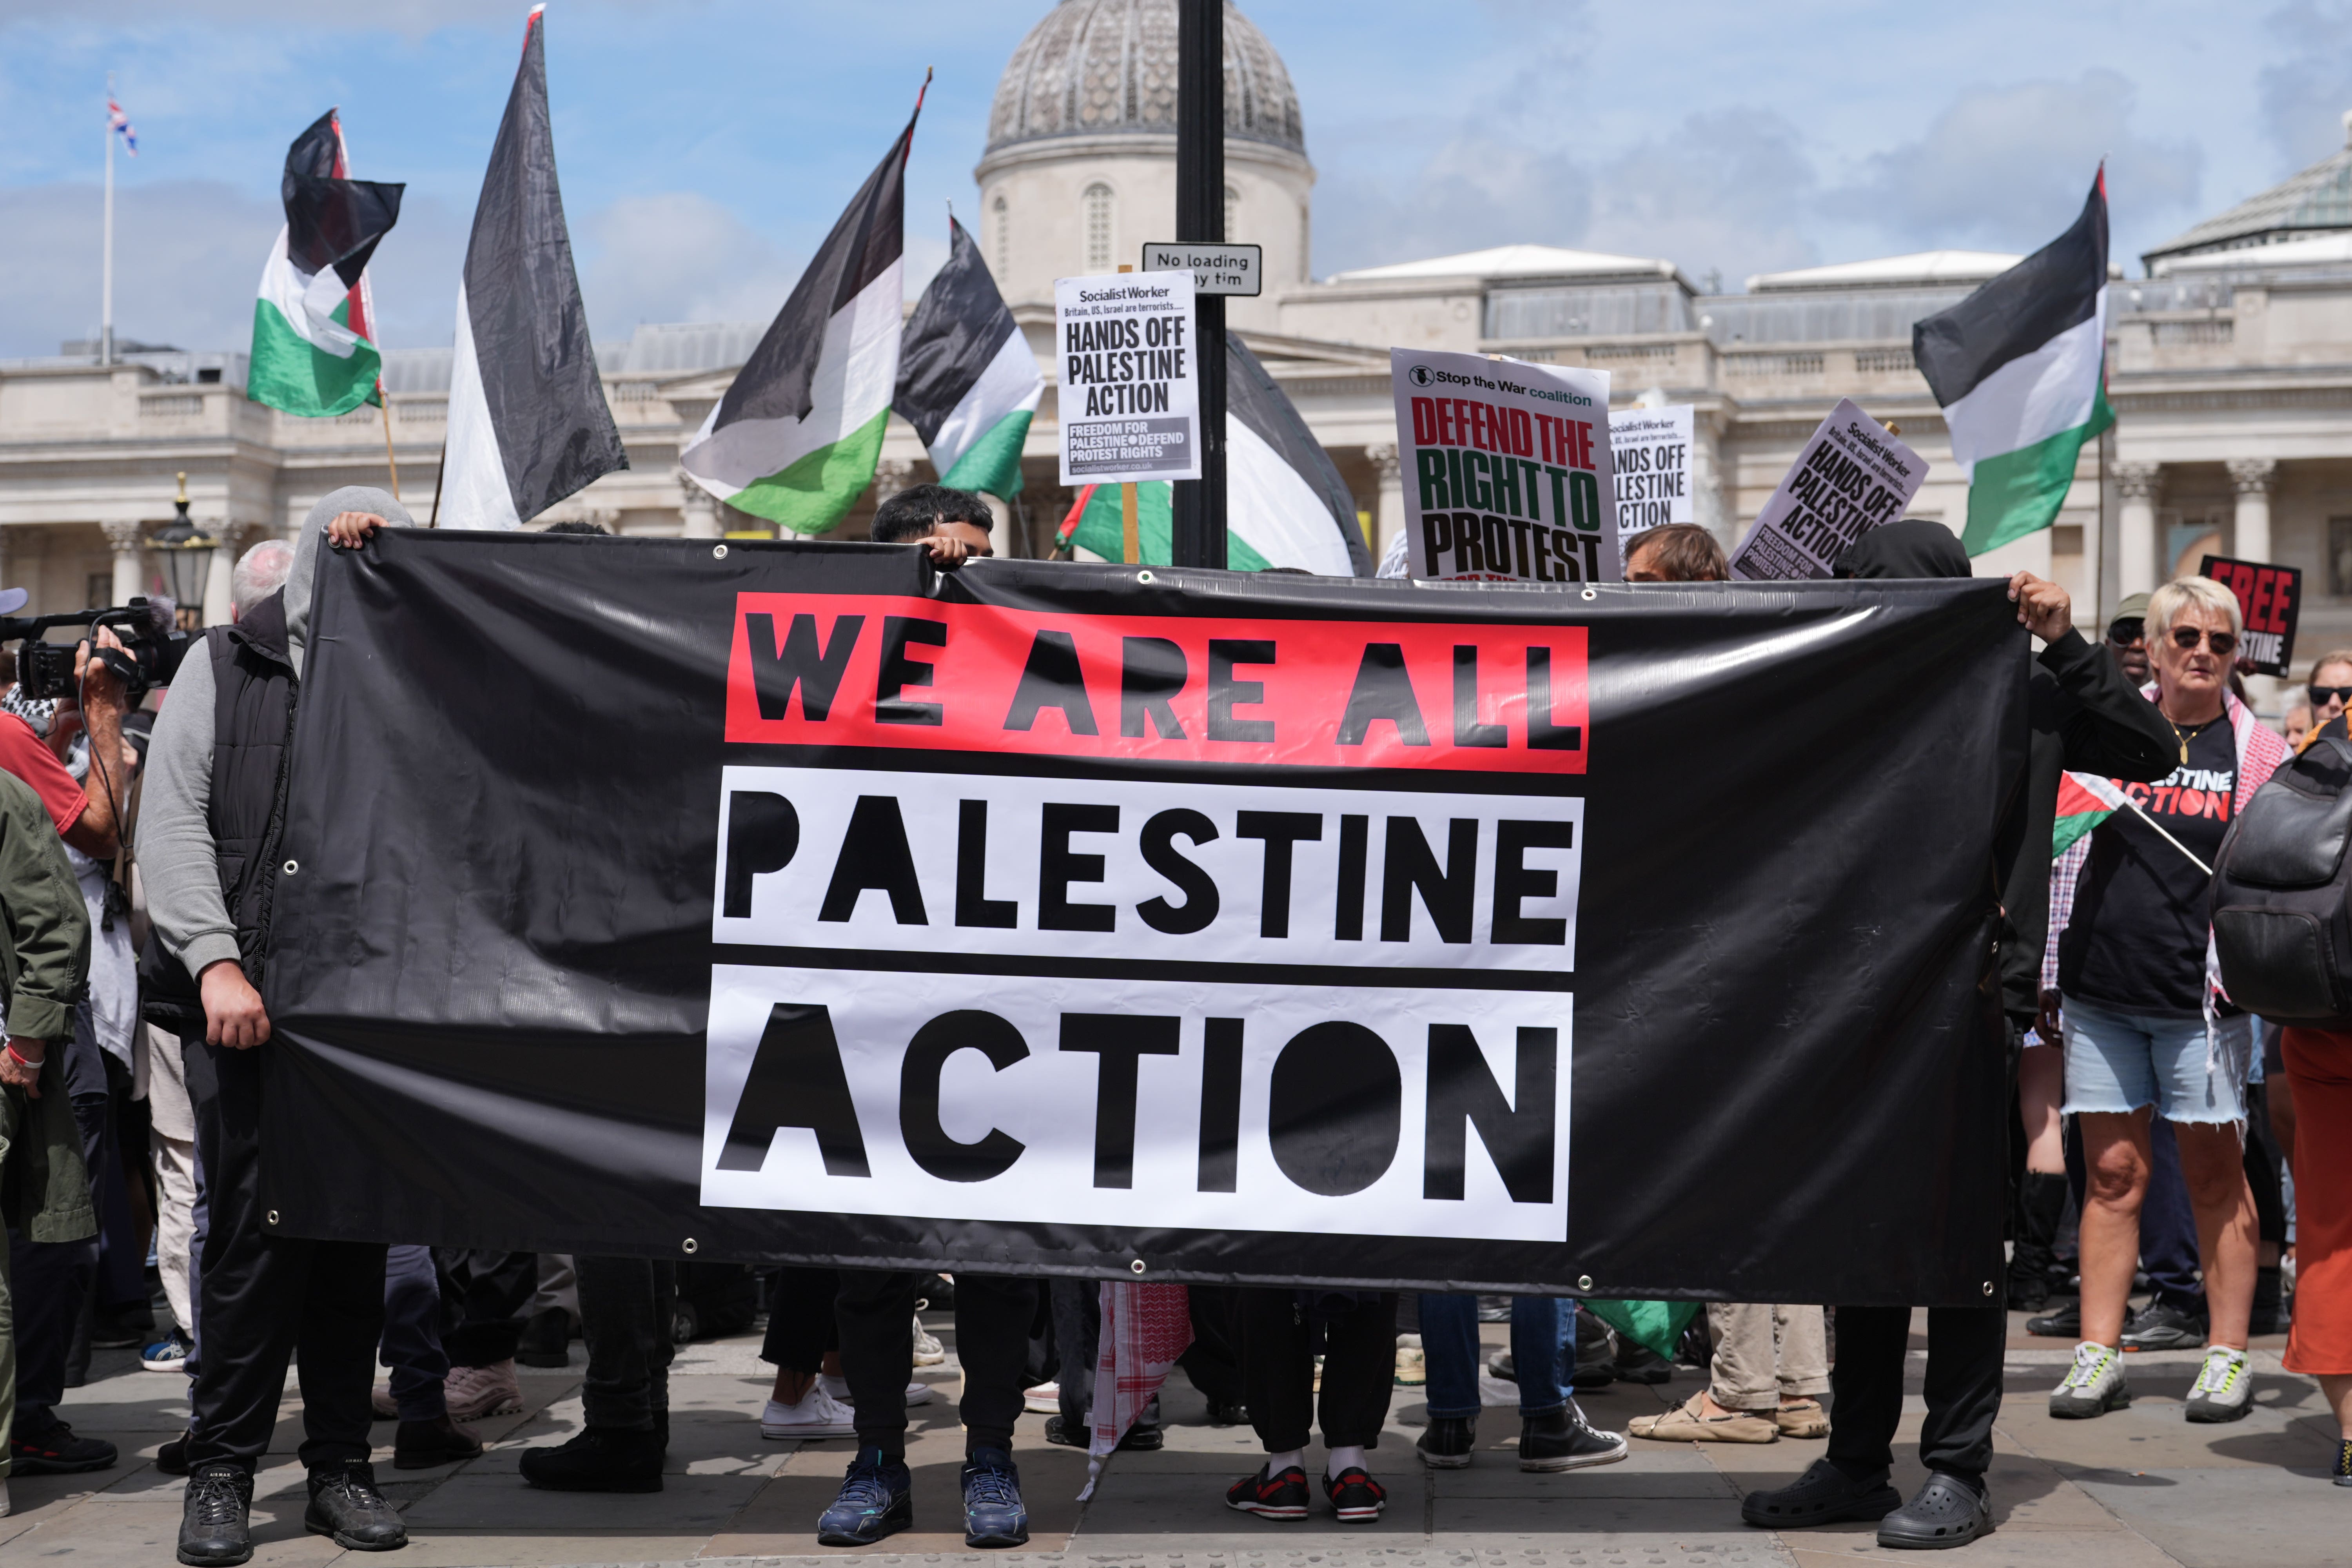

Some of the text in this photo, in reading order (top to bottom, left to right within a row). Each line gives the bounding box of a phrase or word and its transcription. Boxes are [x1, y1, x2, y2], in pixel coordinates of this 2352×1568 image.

[1158, 253, 1248, 270] No loading
[1215, 272, 1241, 285] tim
[1065, 307, 1090, 317] Britain,
[1091, 306, 1102, 316] US,
[1104, 304, 1123, 313] Israel
[1080, 286, 1169, 302] Socialist Worker
[1067, 316, 1185, 352] HANDS OFF
[1068, 348, 1186, 385] PALESTINE
[1085, 382, 1169, 416] ACTION
[1436, 371, 1592, 407] Stop the War coalition
[1069, 422, 1149, 437] FREEDOM FOR
[1070, 432, 1184, 449] PALESTINE DEFEND
[1411, 397, 1596, 470] DEFEND THE
[1642, 419, 1675, 430] Worker
[1070, 446, 1163, 462] PROTEST RIGHTS
[1612, 444, 1685, 474] NDS OFF
[1847, 422, 1911, 478] Socialist Worker
[1072, 461, 1153, 474] socialistworker.co.uk
[1806, 439, 1903, 524] HANDS OFF
[1416, 448, 1601, 531] RIGHT TO
[1616, 472, 1684, 501] LESTINE
[1620, 500, 1671, 528] CTION
[1788, 466, 1879, 542] PALESTIN
[1422, 512, 1602, 582] PROTEST
[1744, 547, 1780, 579] PROTEST
[1751, 537, 1795, 575] PALESTINE
[1759, 527, 1815, 575] FREEDOM FOR
[2238, 630, 2284, 664] STINE
[744, 612, 1583, 752] WE ARE ALL
[2149, 766, 2233, 792] STINE
[721, 790, 1573, 946] PALESTINE
[714, 1002, 1559, 1204] ACTION
